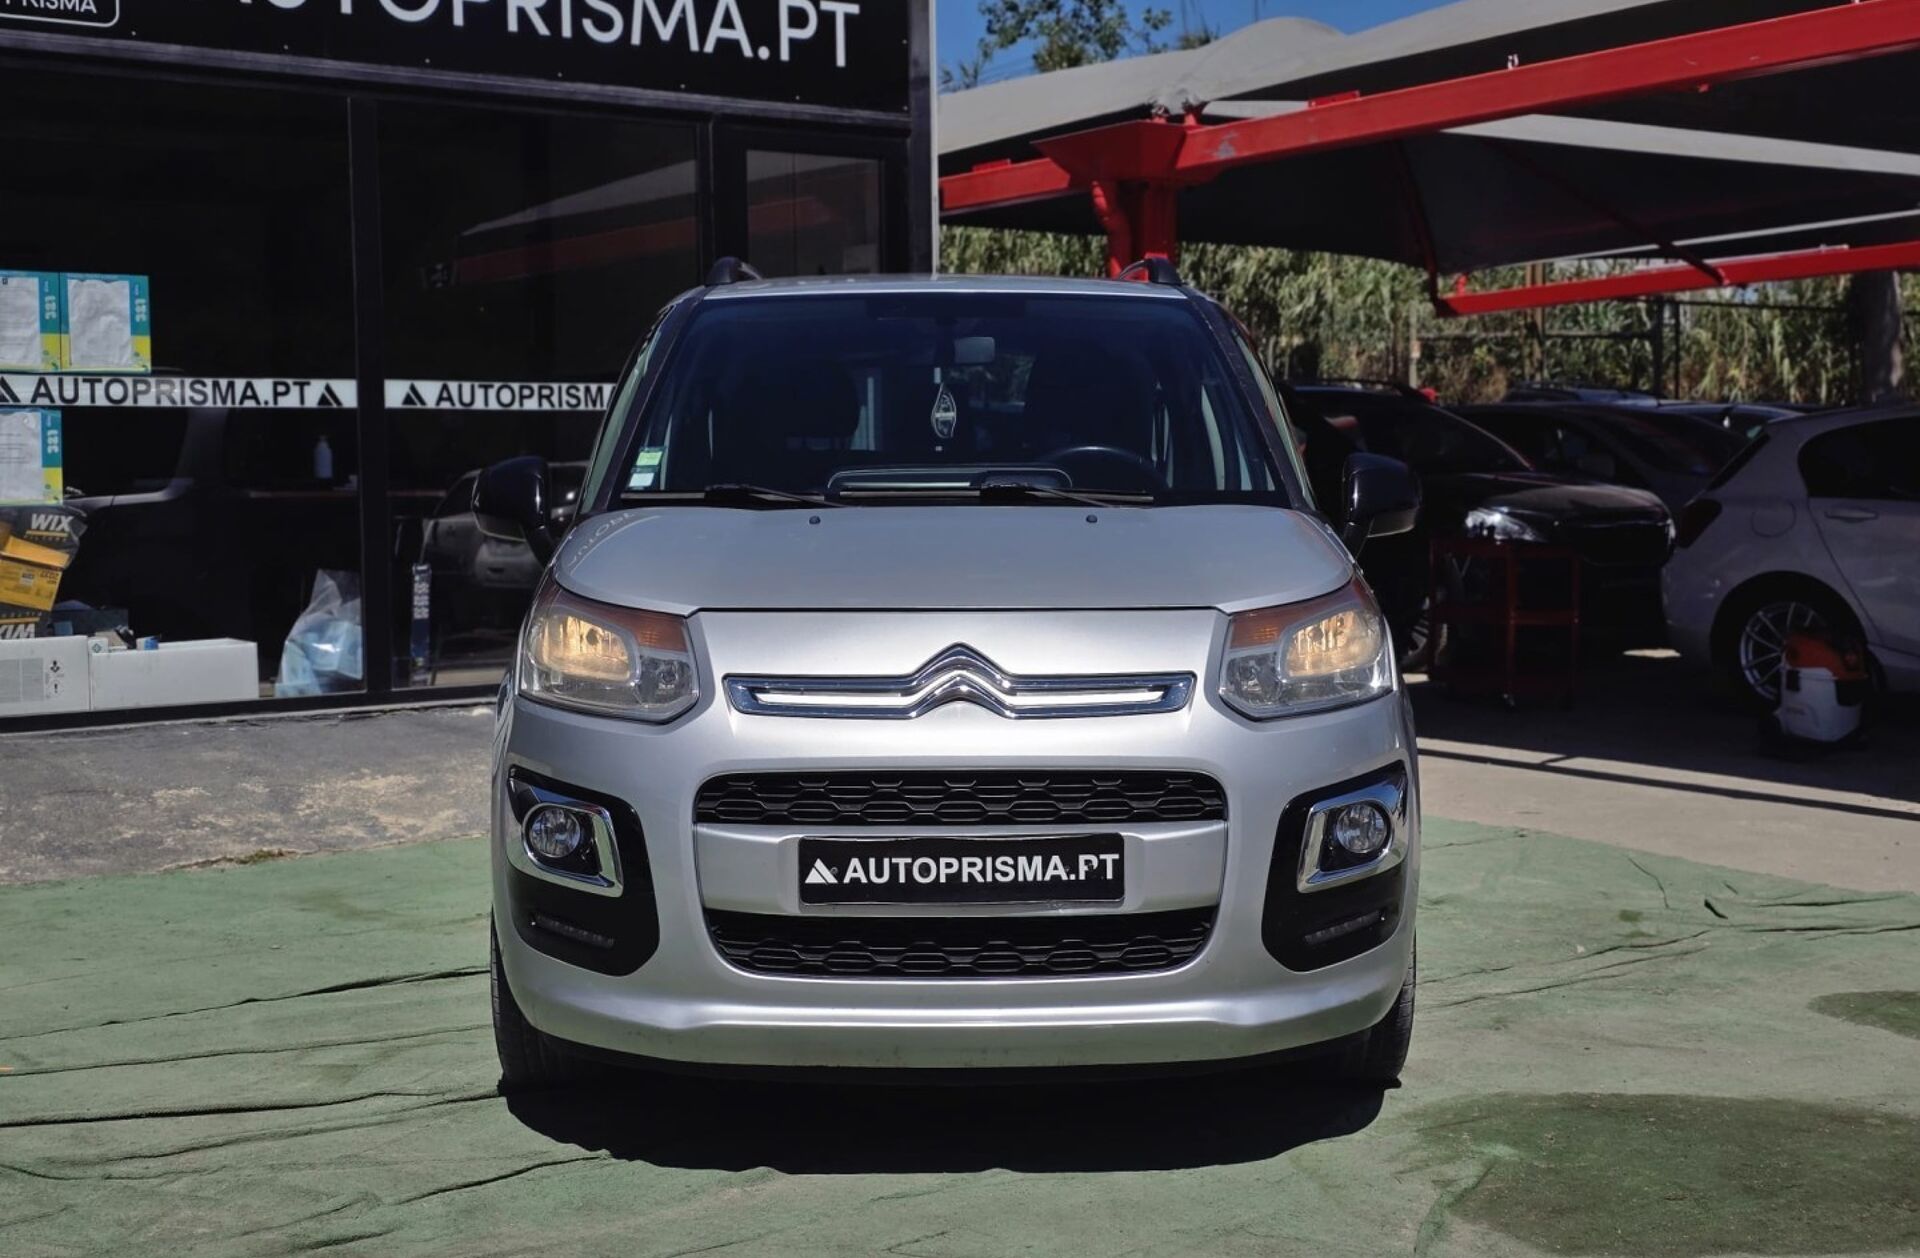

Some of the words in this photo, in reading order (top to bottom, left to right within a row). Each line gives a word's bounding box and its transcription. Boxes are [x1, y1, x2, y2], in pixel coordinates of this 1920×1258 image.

[30, 376, 311, 407] AUTOPRISMA.PT
[435, 382, 615, 409] AUTOPRISM
[31, 512, 74, 532] WIX
[843, 854, 1120, 884] AUTOPRISMA.PT
